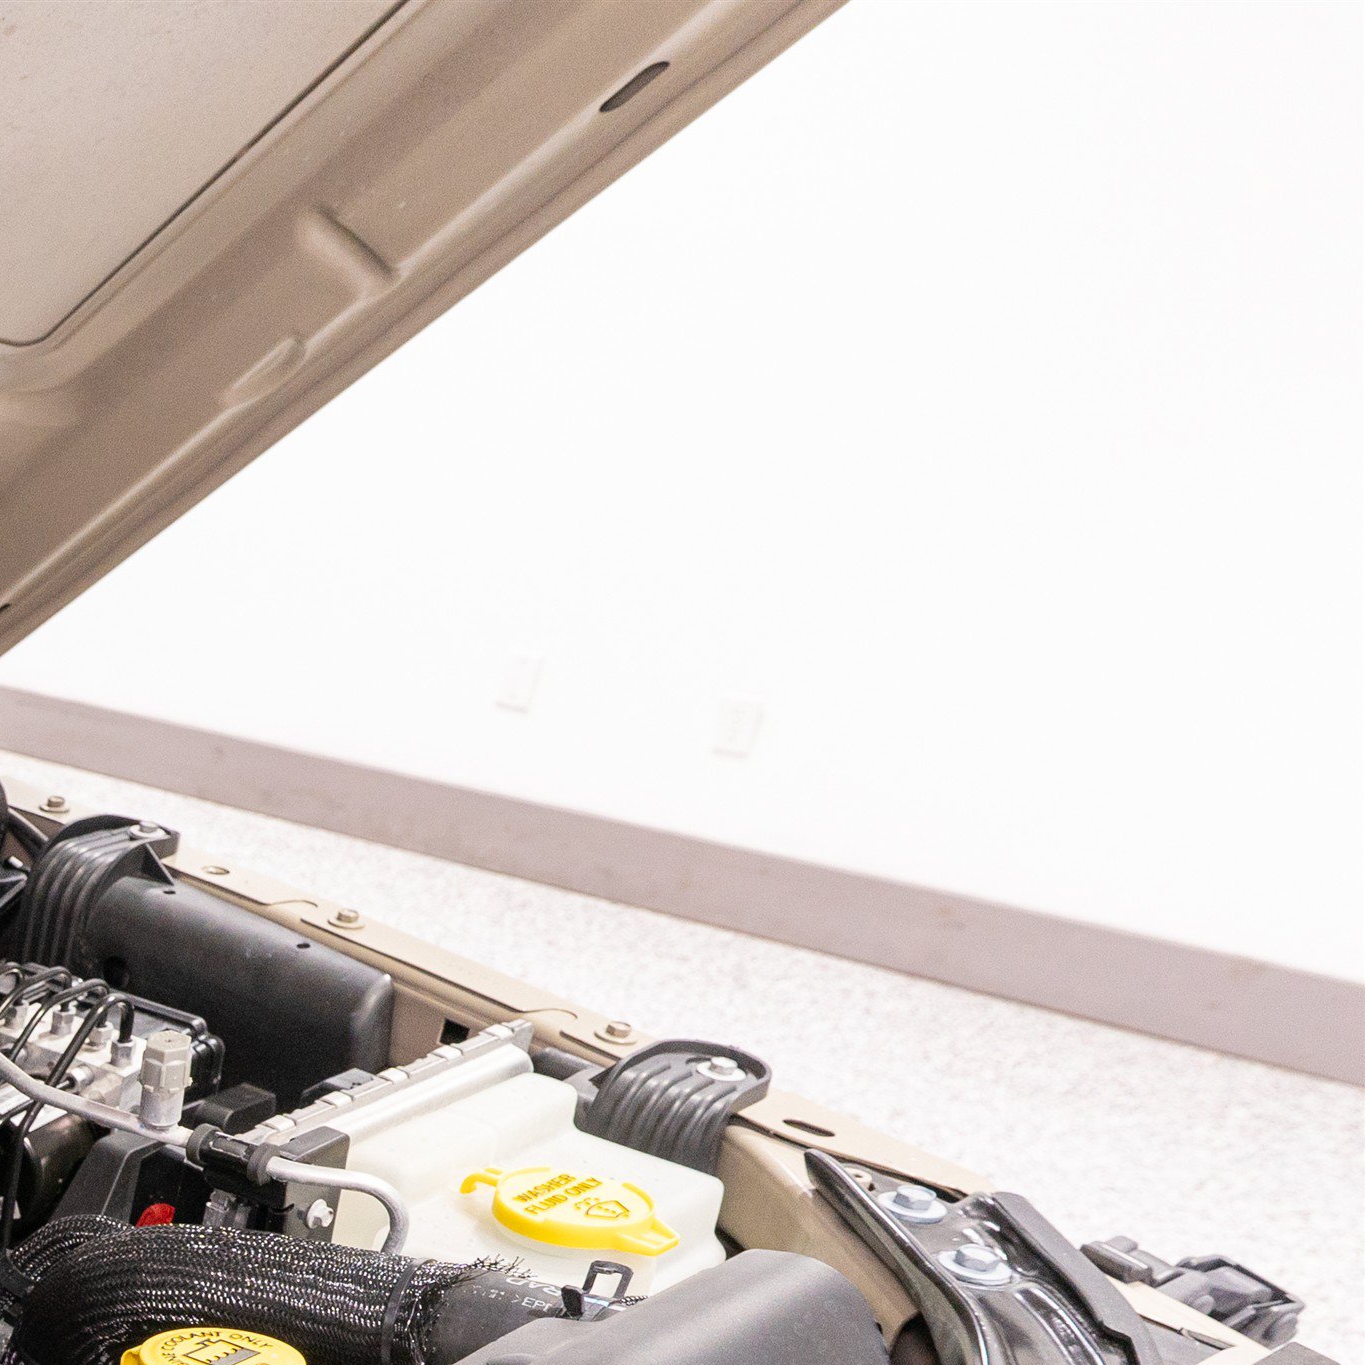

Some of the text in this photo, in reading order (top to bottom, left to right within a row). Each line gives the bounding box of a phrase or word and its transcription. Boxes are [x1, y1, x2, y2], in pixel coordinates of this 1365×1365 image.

[513, 1174, 576, 1202] WASHER
[525, 1177, 603, 1214] FLUID ONLY
[161, 1331, 221, 1351] COOLANT
[229, 1333, 273, 1349] ONLY
